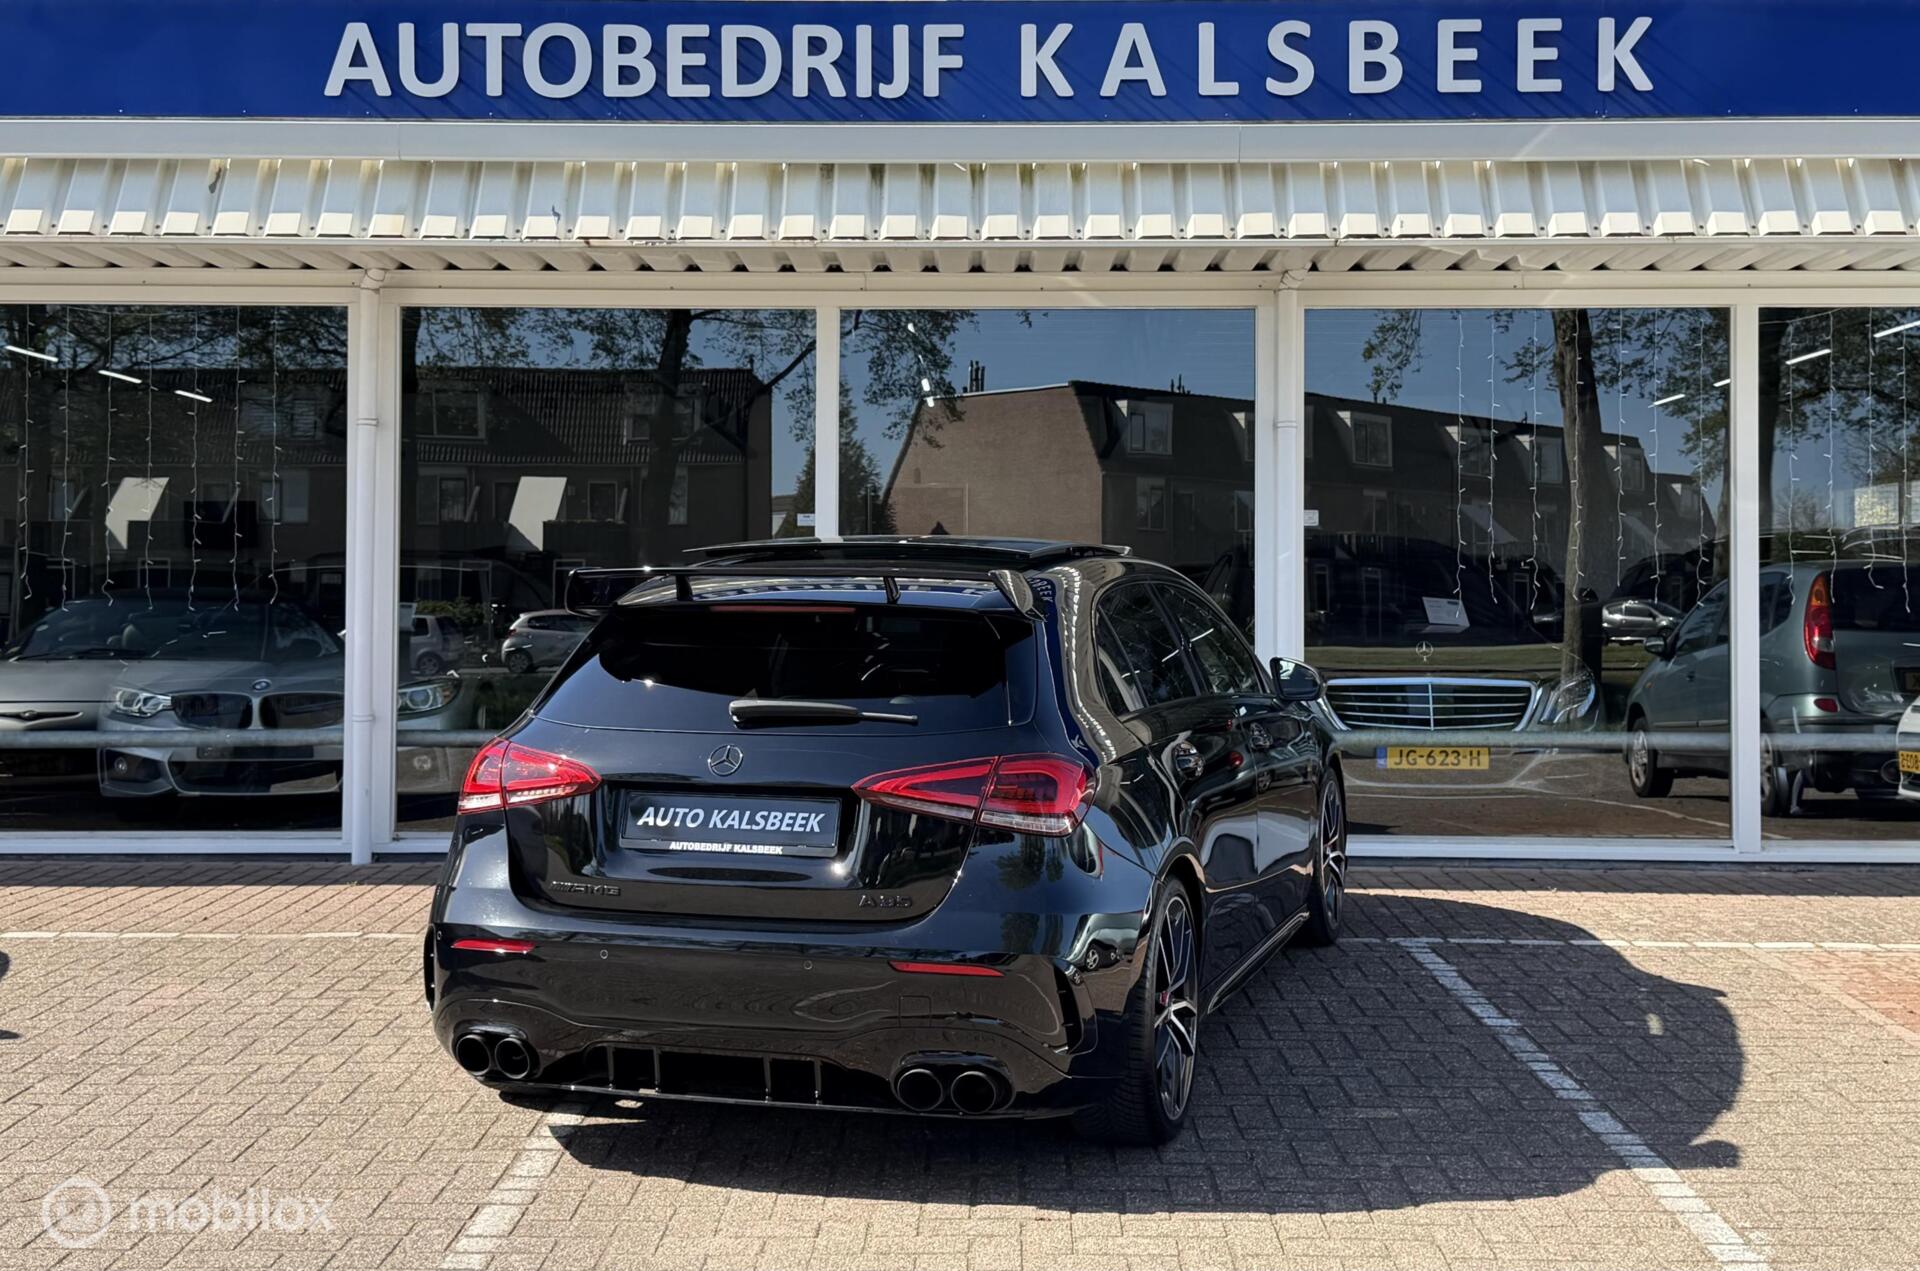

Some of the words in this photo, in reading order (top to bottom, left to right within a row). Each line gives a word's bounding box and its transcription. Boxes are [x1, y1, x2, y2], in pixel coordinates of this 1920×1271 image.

[324, 22, 964, 98] AUTOBEDRIJF
[1019, 17, 1654, 97] KALSBEEK
[1394, 749, 1481, 766] JG-623-H
[636, 806, 705, 828] AUTO
[708, 809, 826, 833] KALSBEEK
[669, 841, 731, 852] AUTOBEDRIJF
[733, 844, 784, 855] KALSBEEK
